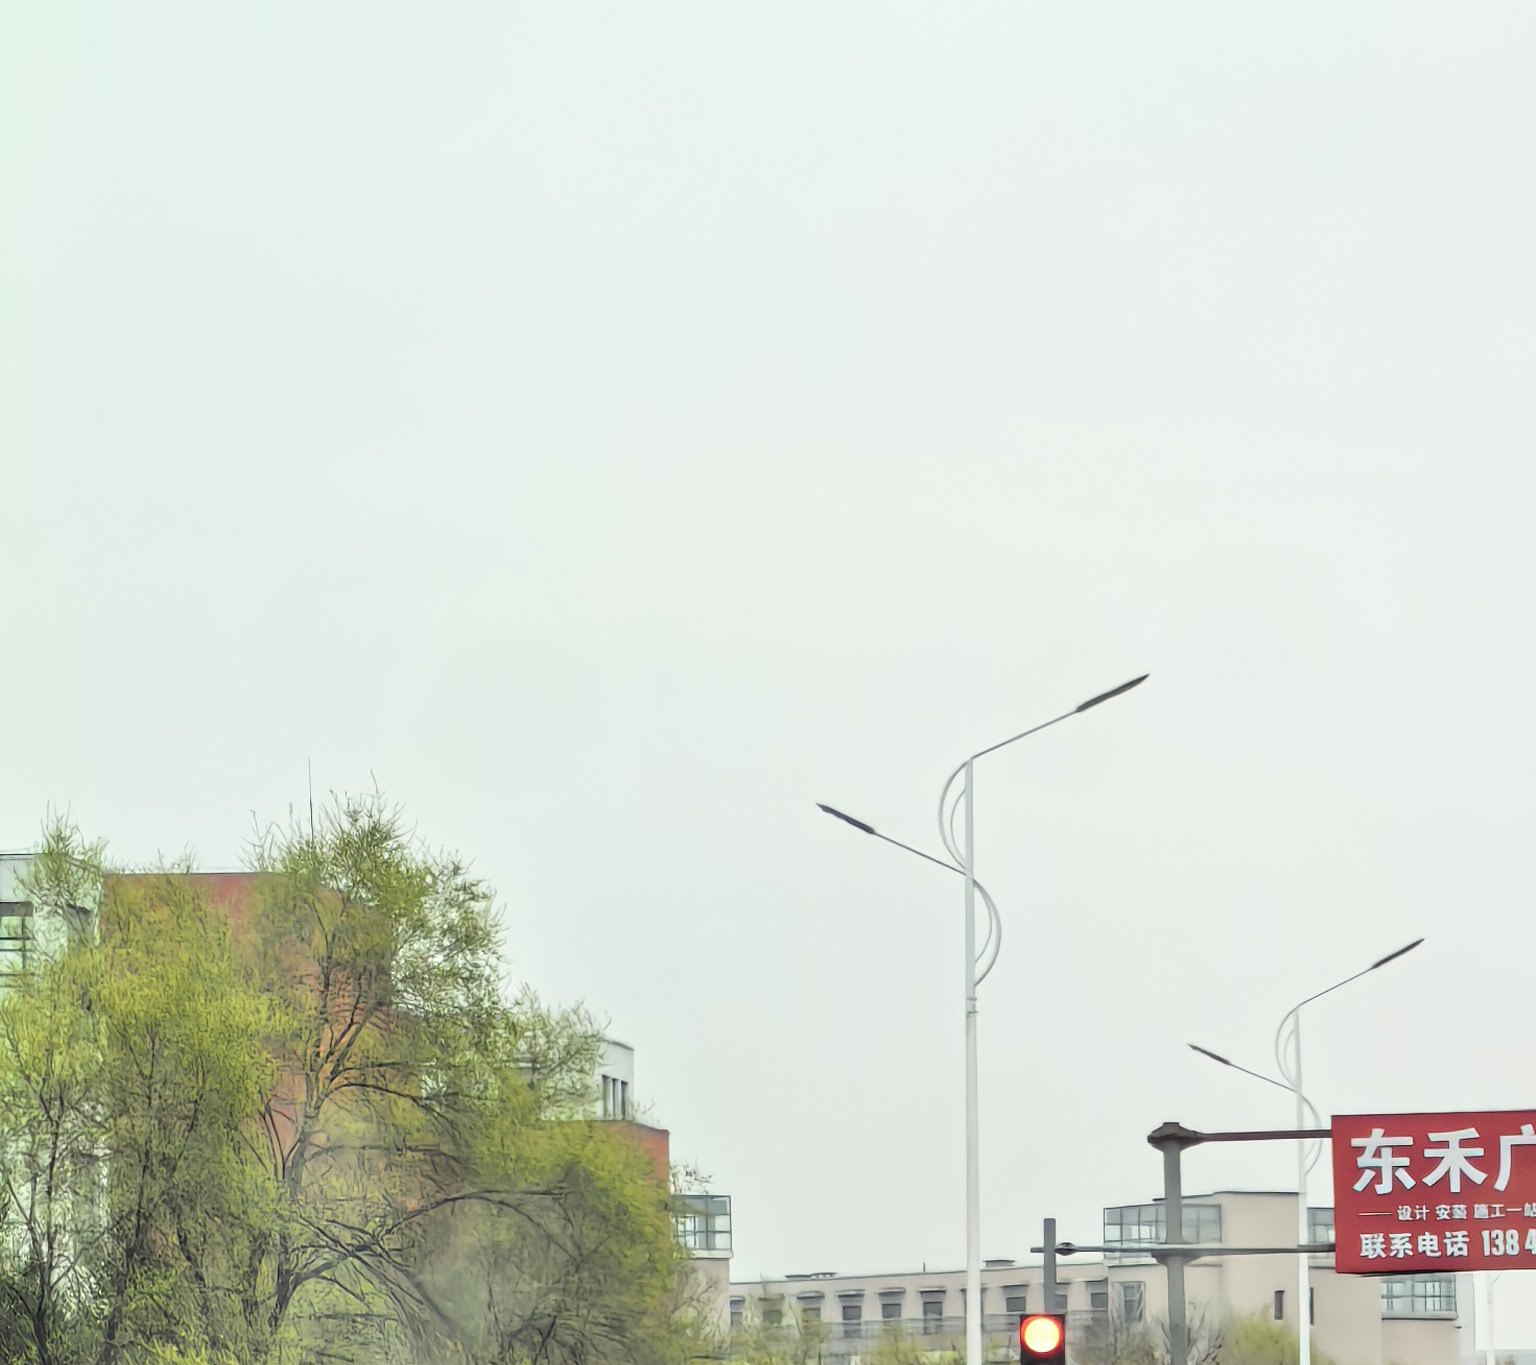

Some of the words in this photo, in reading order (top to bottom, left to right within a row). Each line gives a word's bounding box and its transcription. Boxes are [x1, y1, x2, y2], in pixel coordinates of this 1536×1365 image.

[1396, 1205, 1430, 1221] 设计
[1359, 1230, 1471, 1259] 联系电话
[1481, 1228, 1520, 1257] 138
